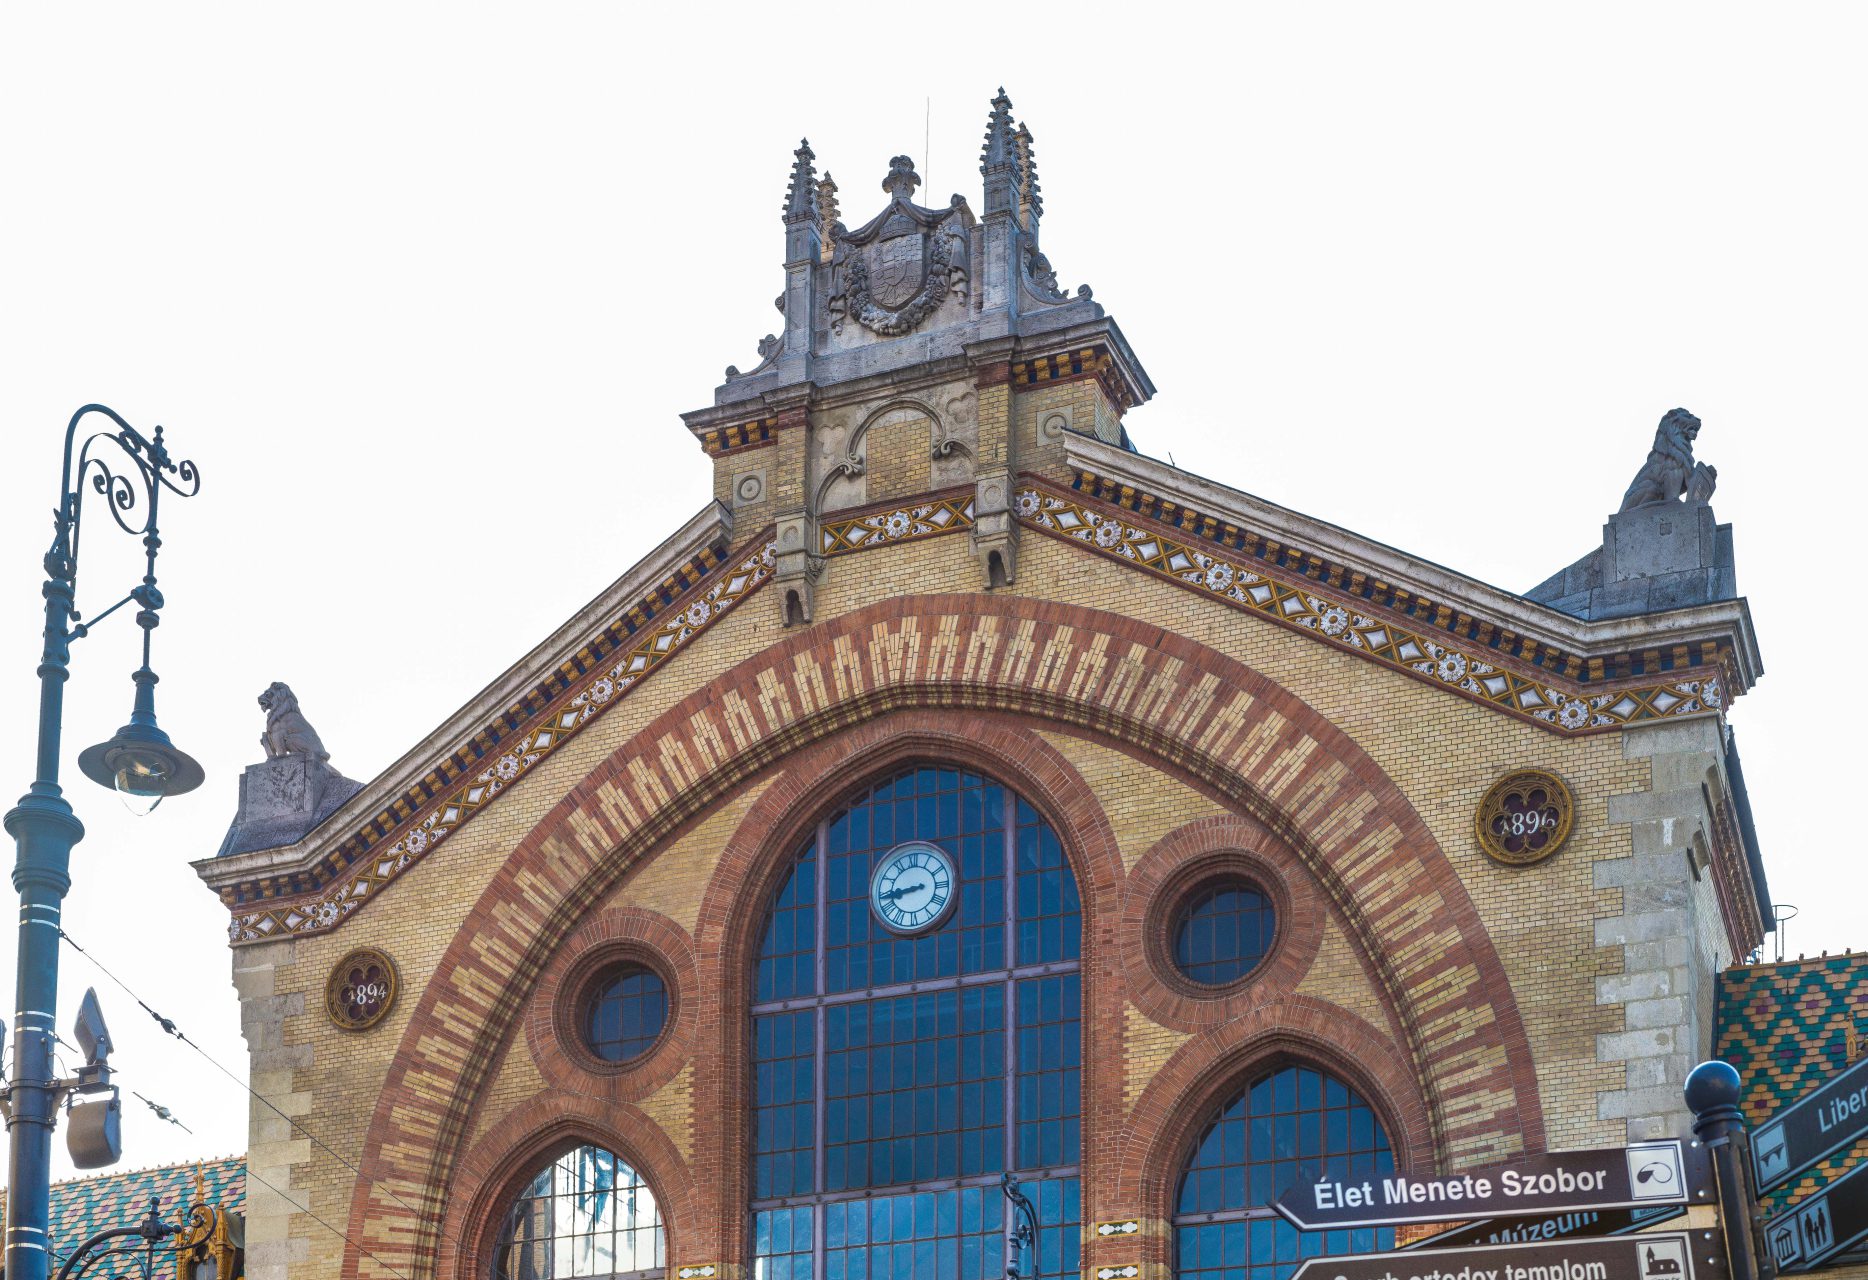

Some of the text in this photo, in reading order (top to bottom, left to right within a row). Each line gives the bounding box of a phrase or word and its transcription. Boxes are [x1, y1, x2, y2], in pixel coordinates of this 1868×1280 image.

[1500, 810, 1556, 836] 1896
[348, 983, 387, 1005] 1894
[1314, 1167, 1607, 1210] Élet Menete Szobor
